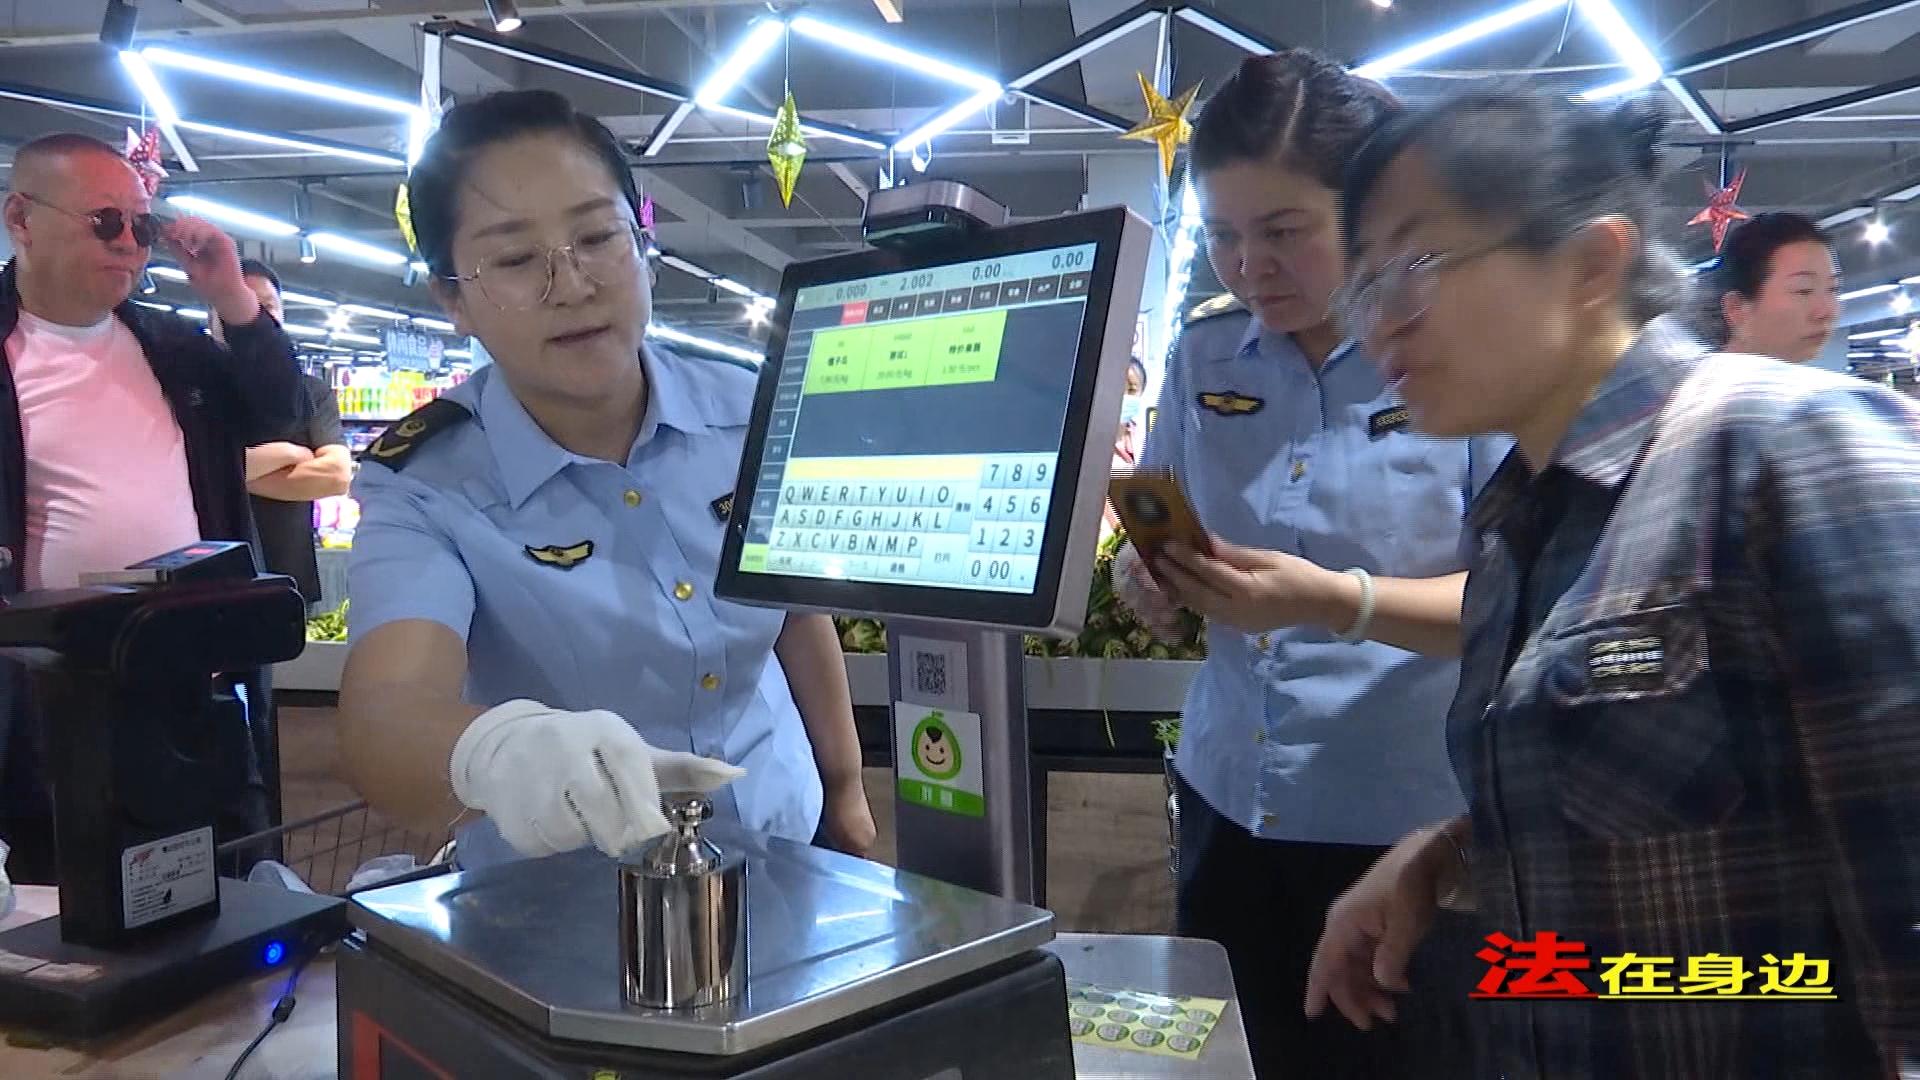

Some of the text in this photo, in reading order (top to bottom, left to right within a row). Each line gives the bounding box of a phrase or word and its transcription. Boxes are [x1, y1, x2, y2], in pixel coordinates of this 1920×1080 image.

[1051, 250, 1084, 270] 0.00
[972, 262, 1001, 281] 0.00
[899, 273, 934, 292] 2.002
[990, 463, 1047, 482] 7 8 9
[785, 486, 795, 505] Q
[802, 487, 814, 501] W
[820, 485, 830, 502] E
[838, 486, 849, 502] R
[859, 485, 868, 503] T
[879, 487, 887, 503] Y
[896, 487, 907, 503] U
[937, 486, 949, 504] O
[983, 496, 993, 513] 4
[1005, 495, 1016, 514] 5
[1030, 496, 1041, 515] 6
[780, 508, 942, 529] A S D F G H J K L
[776, 531, 918, 554] Z X C V B N M P
[999, 529, 1010, 547] 2
[1023, 529, 1035, 548] 3
